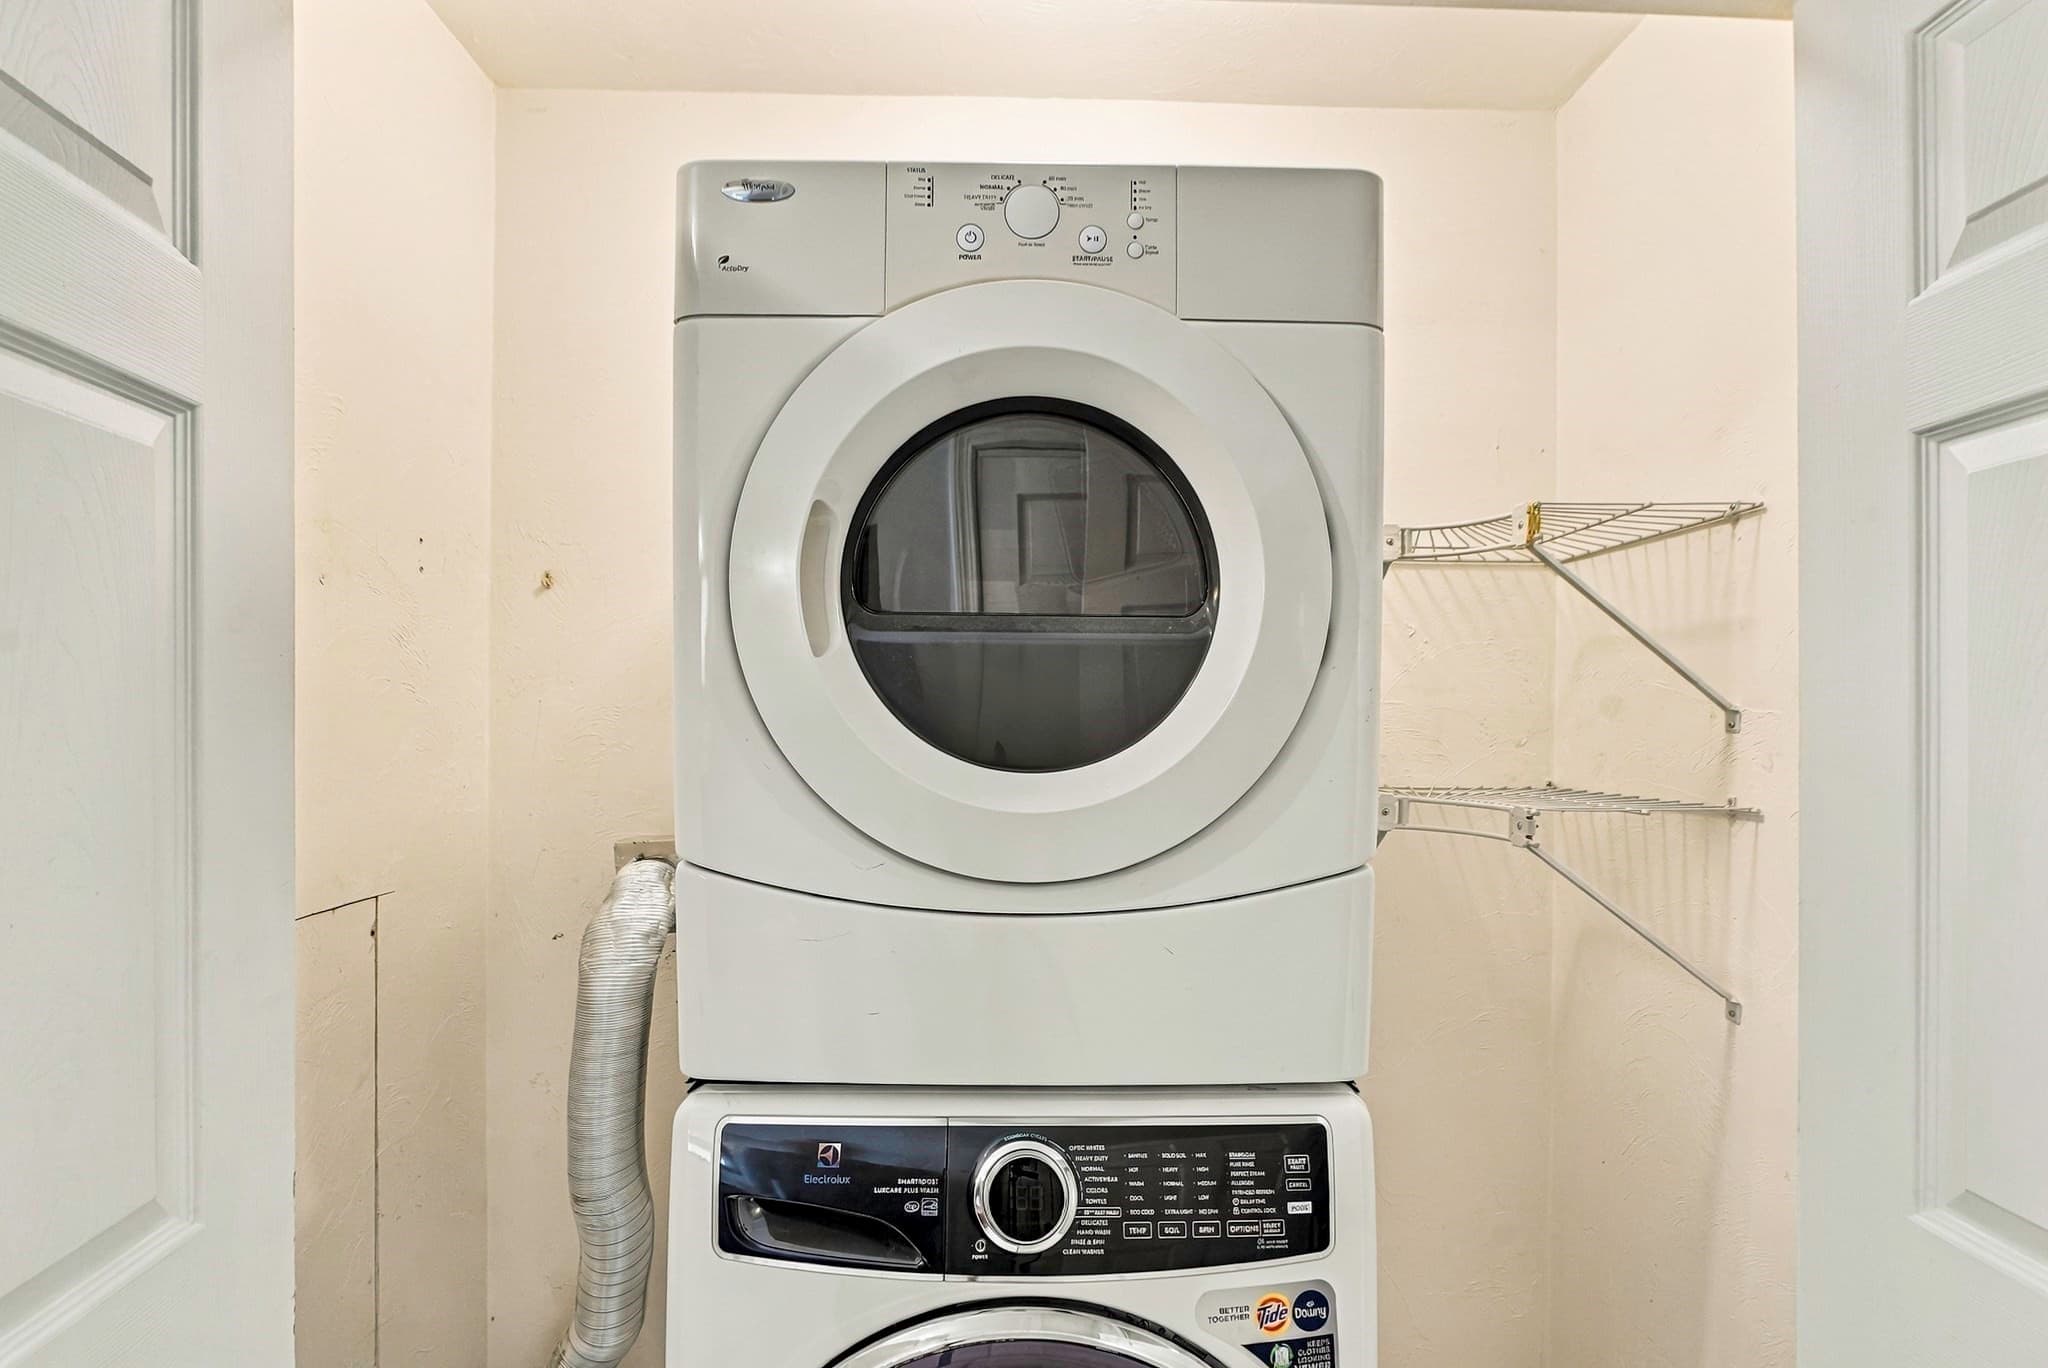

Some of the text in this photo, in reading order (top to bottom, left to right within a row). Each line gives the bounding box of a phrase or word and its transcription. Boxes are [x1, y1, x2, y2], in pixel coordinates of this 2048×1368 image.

[803, 1174, 851, 1185] Electrolux
[873, 1186, 940, 1194] LUXCARE PLUS WASH
[1164, 1226, 1180, 1234] SOIL
[1229, 1225, 1260, 1233] OPTIONS
[1218, 1304, 1250, 1315] BETTER
[1294, 1305, 1327, 1319] Downy
[1207, 1313, 1250, 1324] TOGETHER
[1256, 1303, 1289, 1330] Tide
[1306, 1338, 1331, 1348] KEEPS
[1297, 1353, 1331, 1364] LOOKING
